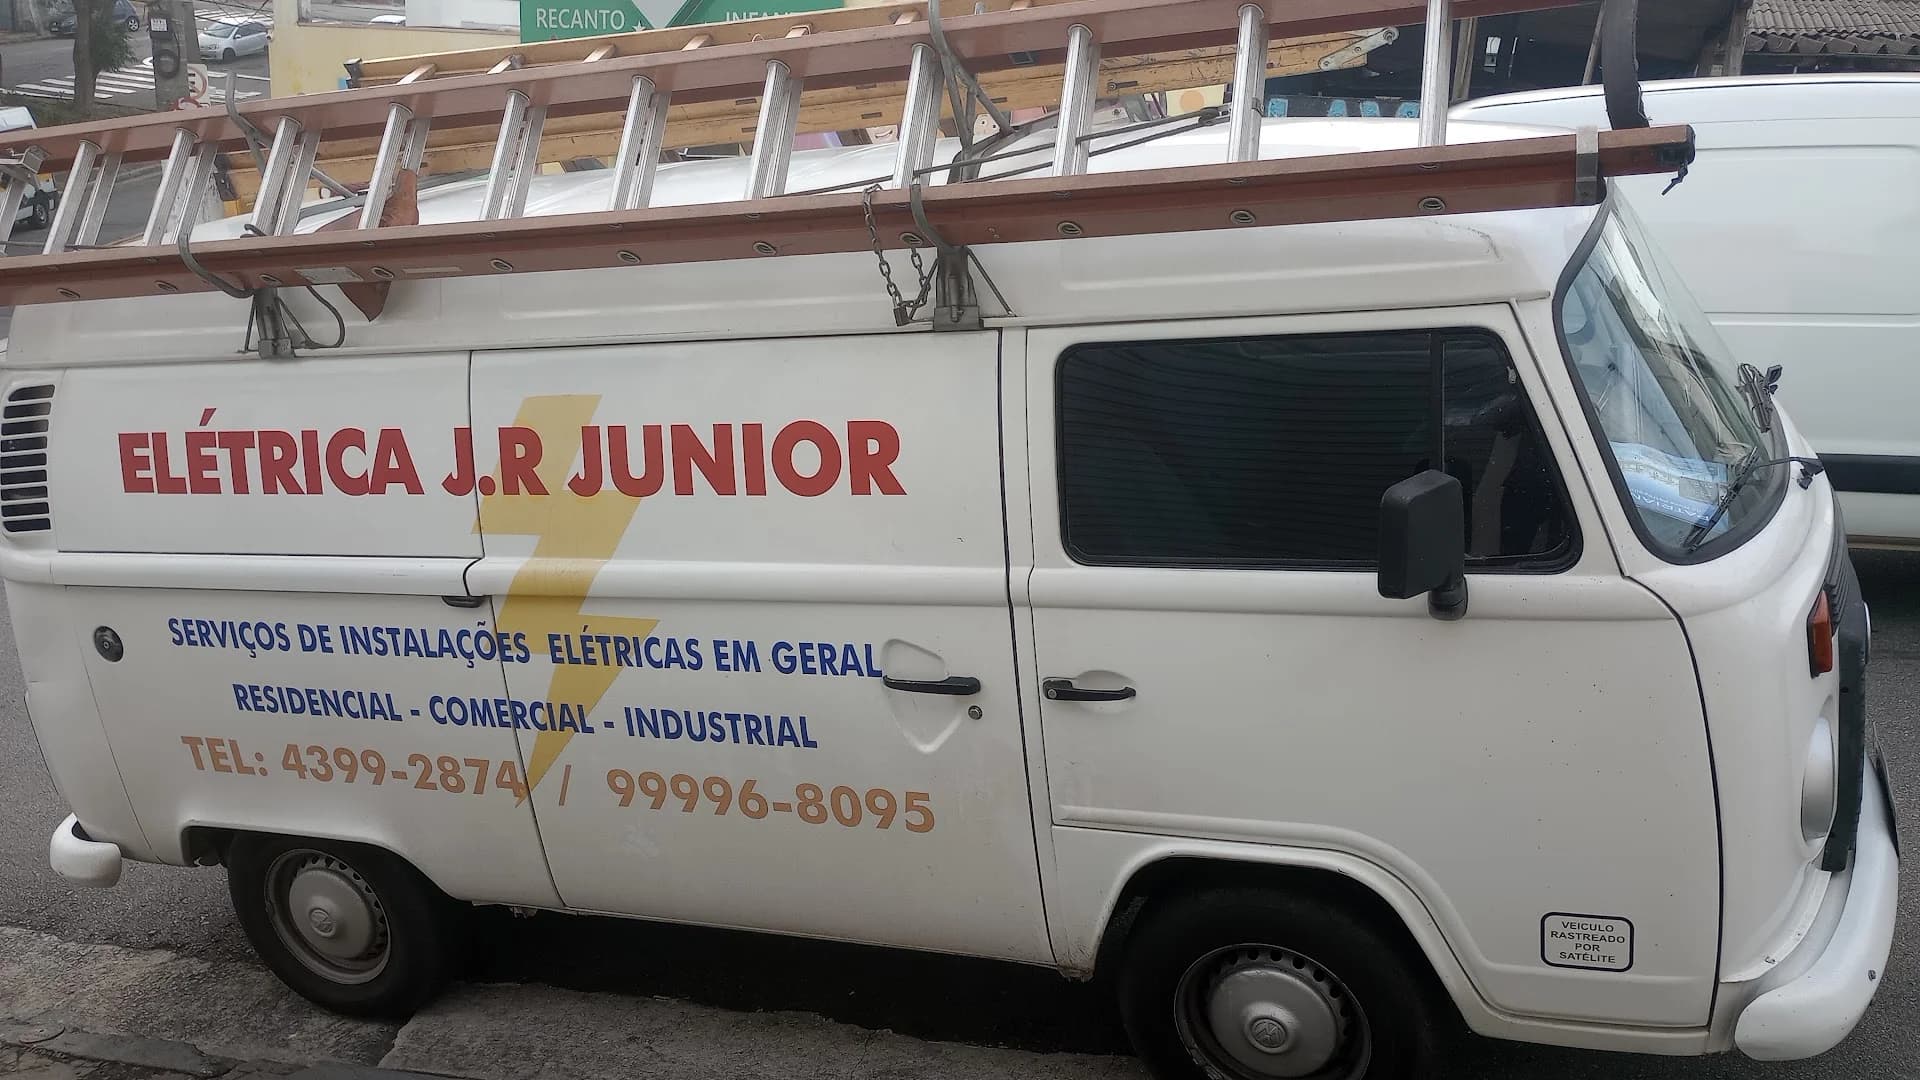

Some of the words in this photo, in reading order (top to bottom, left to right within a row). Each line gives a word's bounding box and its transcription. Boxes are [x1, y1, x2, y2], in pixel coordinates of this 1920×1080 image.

[536, 8, 625, 31] RECANTO
[118, 407, 425, 497] ELÉTRICA
[441, 425, 550, 497] J.R
[567, 419, 907, 498] JUNIOR
[168, 618, 291, 659] SERVIÇOS
[297, 623, 334, 654] DE
[340, 620, 531, 669] INSTALAÇÕES
[547, 625, 703, 671] ELÉTRICAS
[712, 639, 761, 673] EM
[771, 641, 883, 678] GERAL
[232, 683, 403, 722] RESIDENCIAL
[429, 695, 595, 735] COMERCIAL
[624, 706, 818, 749] INDUSTRIAL
[181, 735, 268, 777] TEL:
[281, 743, 525, 799] 4399-2874
[606, 768, 936, 834] 99996-8095
[1550, 930, 1625, 943] RASTREADO
[1575, 942, 1601, 952] POR
